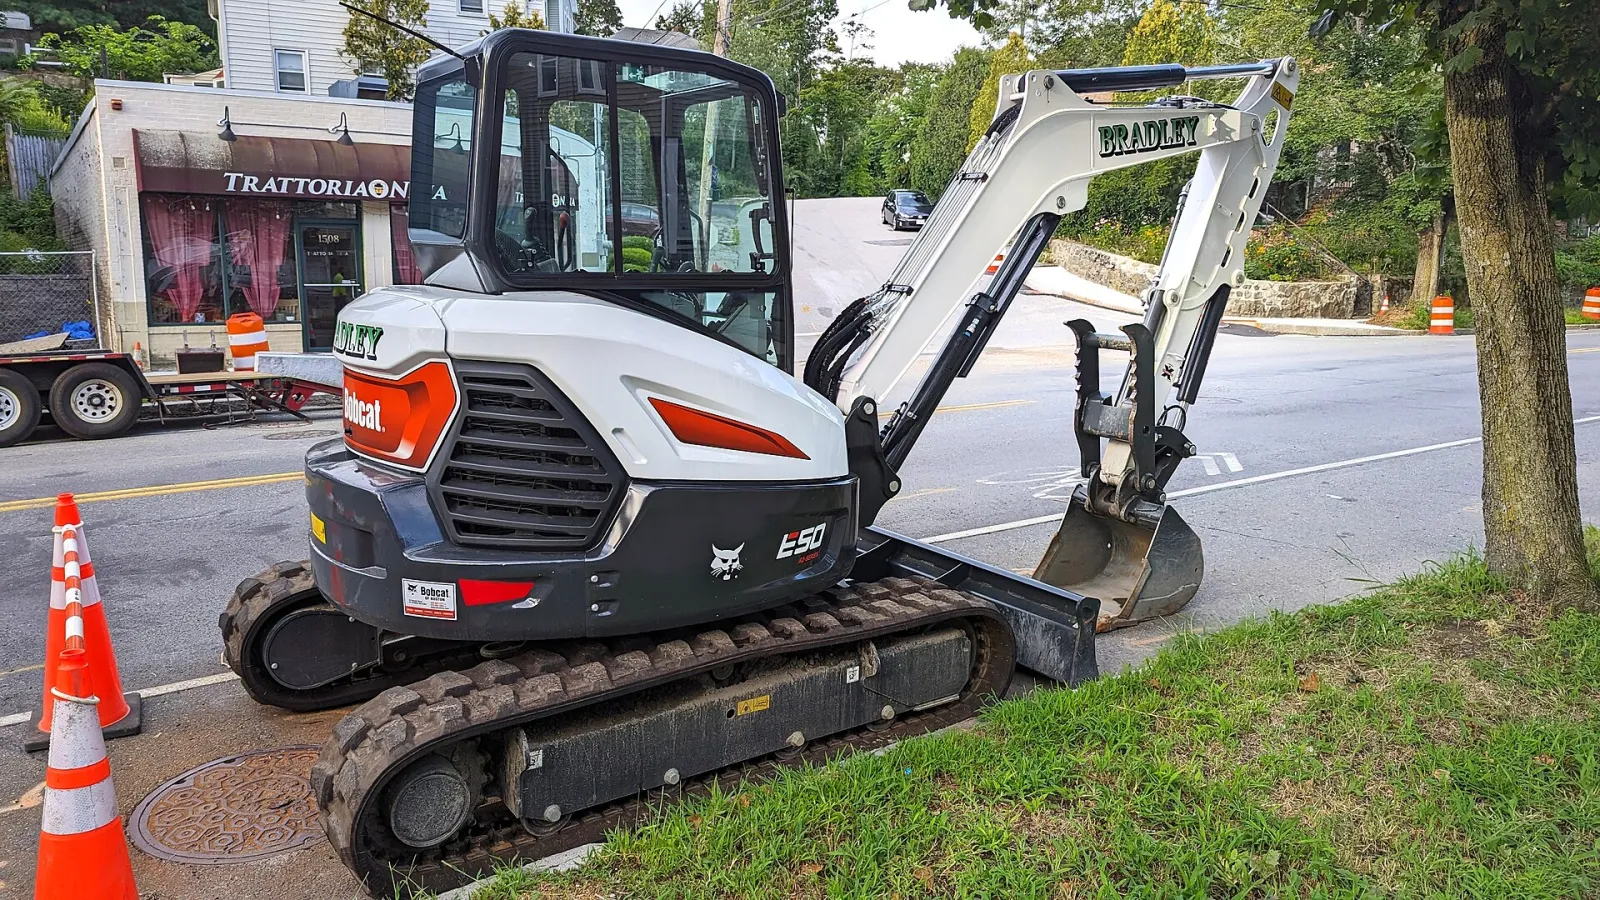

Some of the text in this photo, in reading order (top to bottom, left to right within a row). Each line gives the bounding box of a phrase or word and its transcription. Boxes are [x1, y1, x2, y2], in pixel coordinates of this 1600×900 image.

[1099, 116, 1199, 158] BRADLEY
[318, 234, 340, 244] 1508
[344, 387, 381, 433] Bobcat
[776, 522, 826, 559] E50
[420, 586, 449, 598] Bobcat
